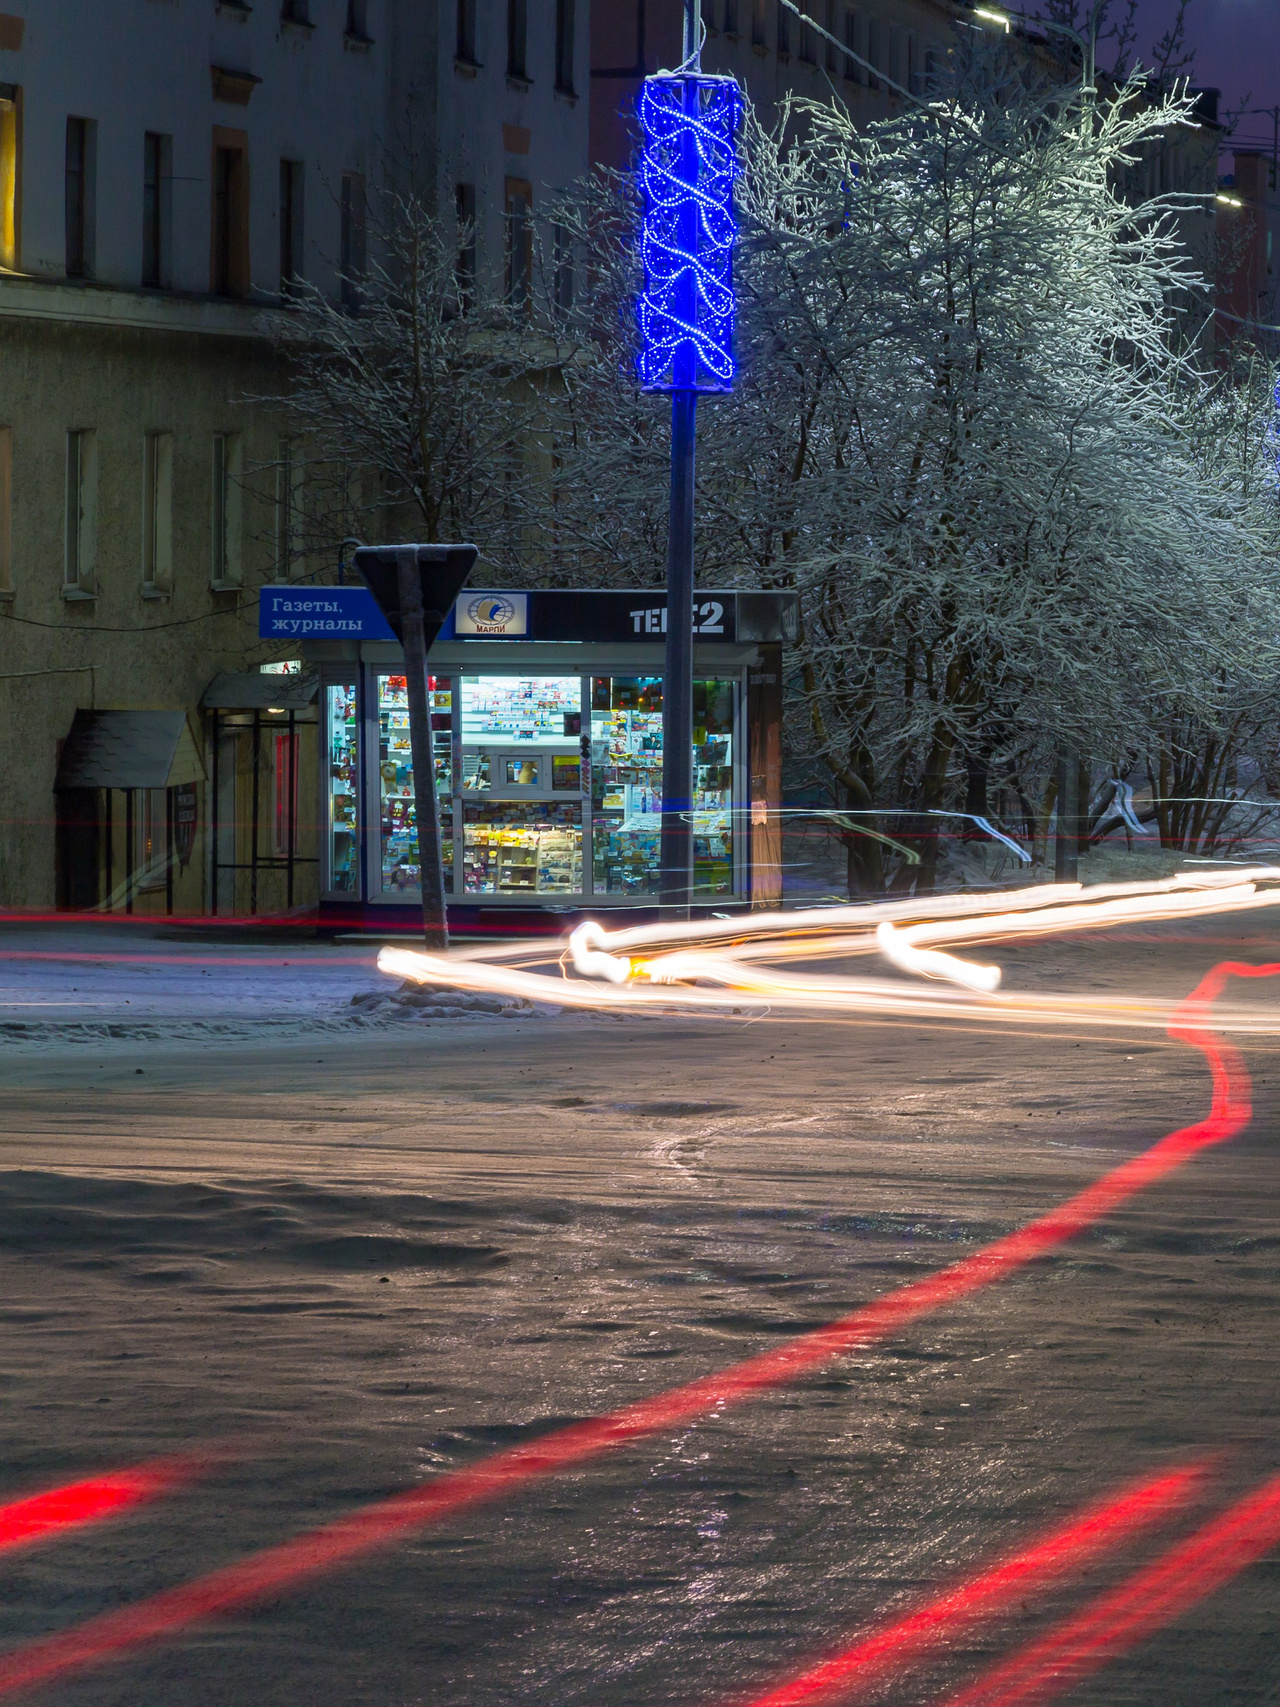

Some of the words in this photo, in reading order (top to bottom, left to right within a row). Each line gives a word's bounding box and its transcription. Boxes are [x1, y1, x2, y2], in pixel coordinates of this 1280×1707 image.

[272, 598, 343, 613] Газеты,
[629, 601, 724, 634] TE2
[272, 619, 363, 633] журналы
[476, 624, 506, 633] МАРПИ
